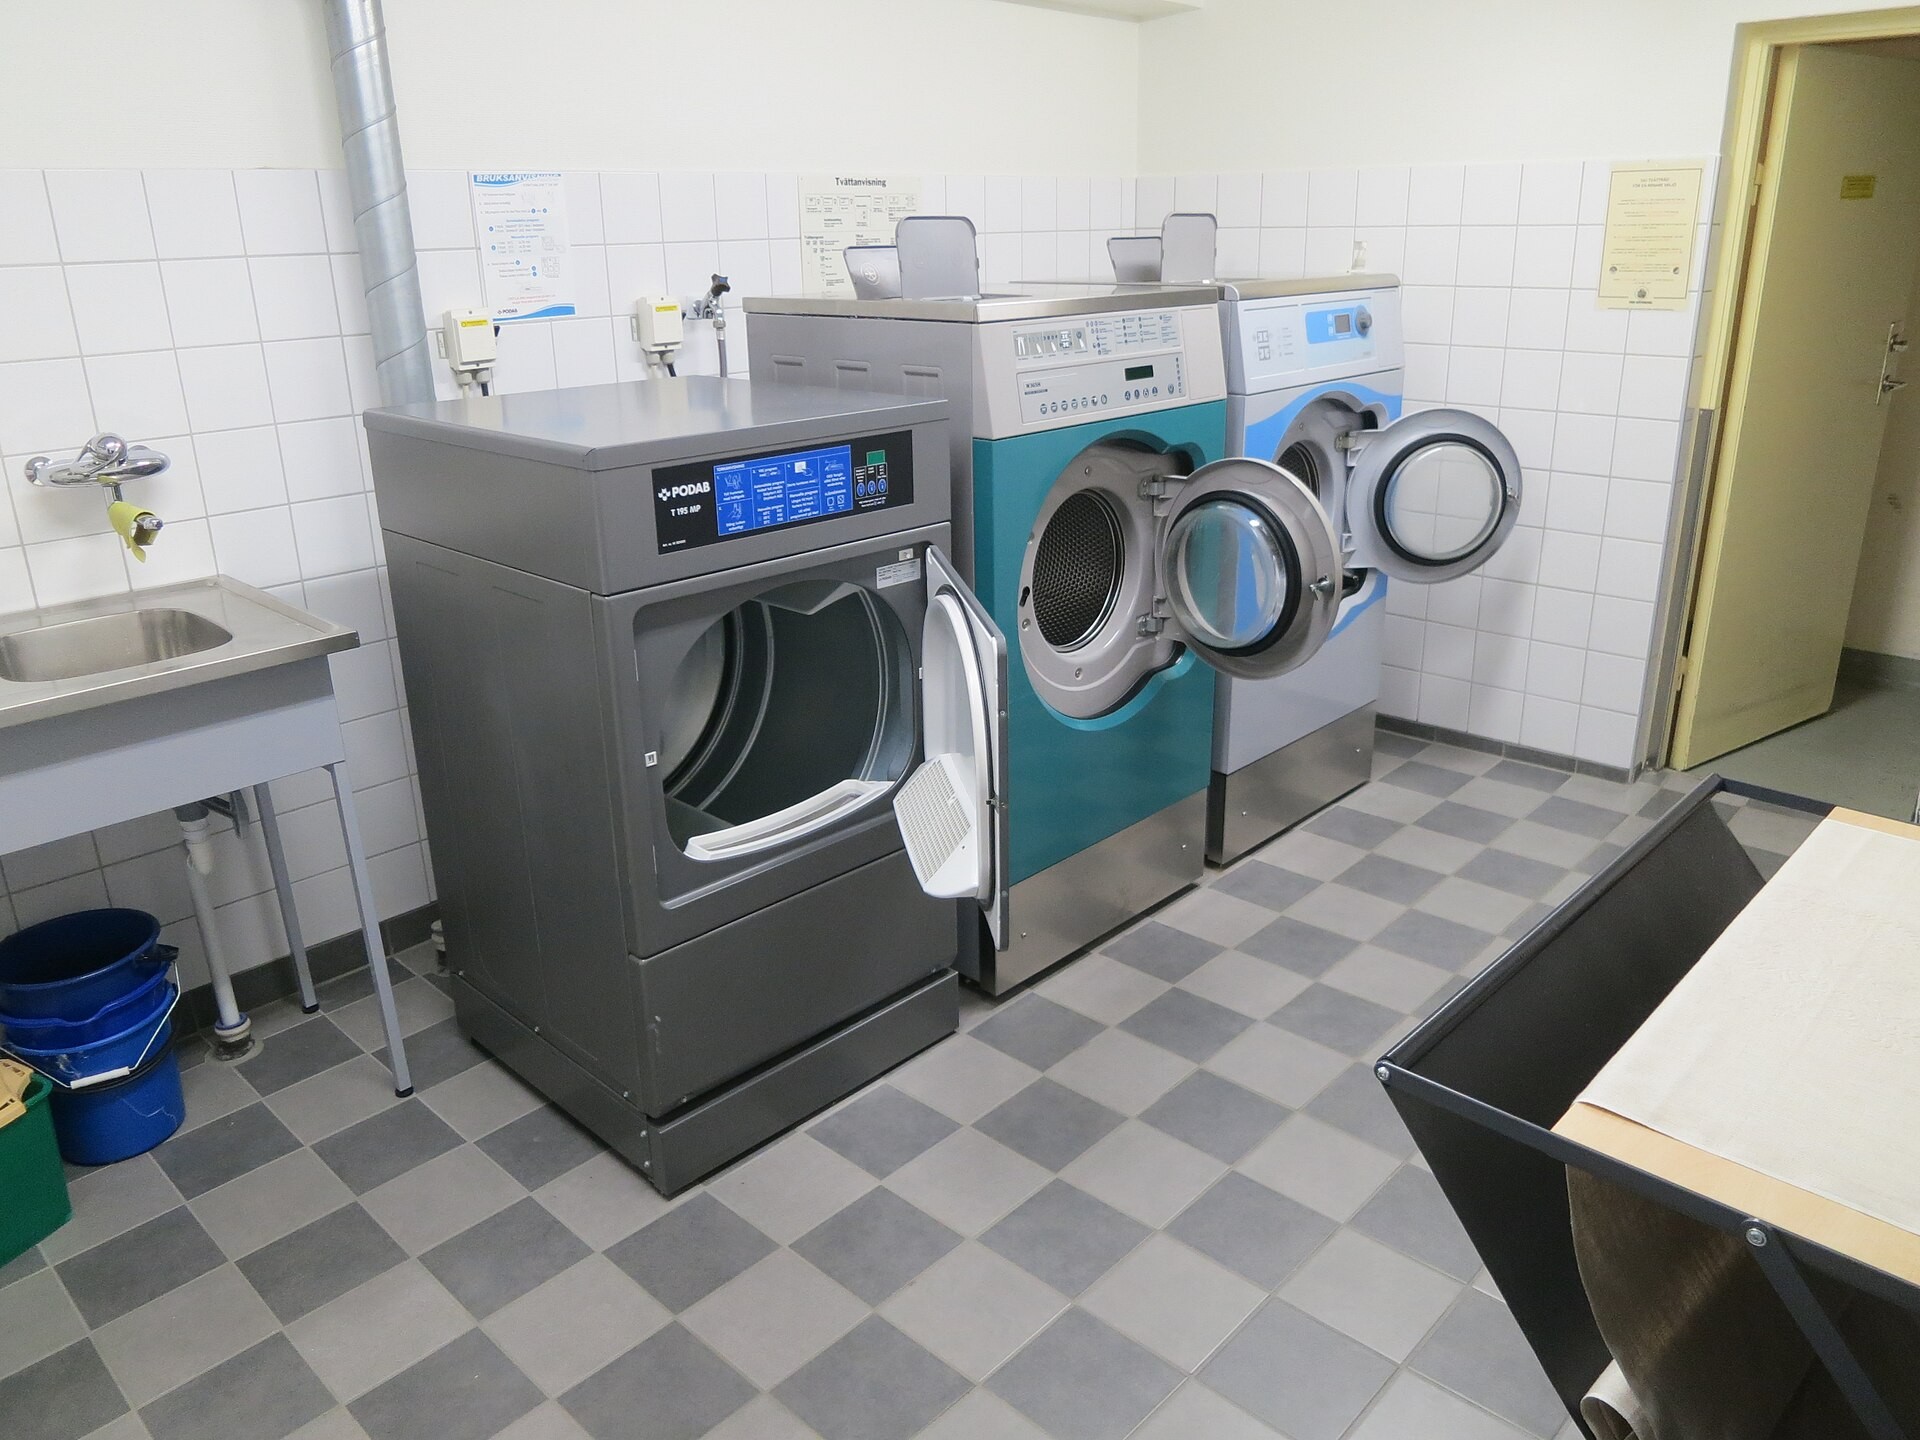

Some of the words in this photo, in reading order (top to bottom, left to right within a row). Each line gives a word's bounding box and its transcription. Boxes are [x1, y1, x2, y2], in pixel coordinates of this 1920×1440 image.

[835, 177, 887, 187] Tvättanvisning
[672, 482, 711, 498] PODAB
[670, 508, 676, 517] T
[677, 506, 688, 516] 195
[690, 504, 701, 514] MP
